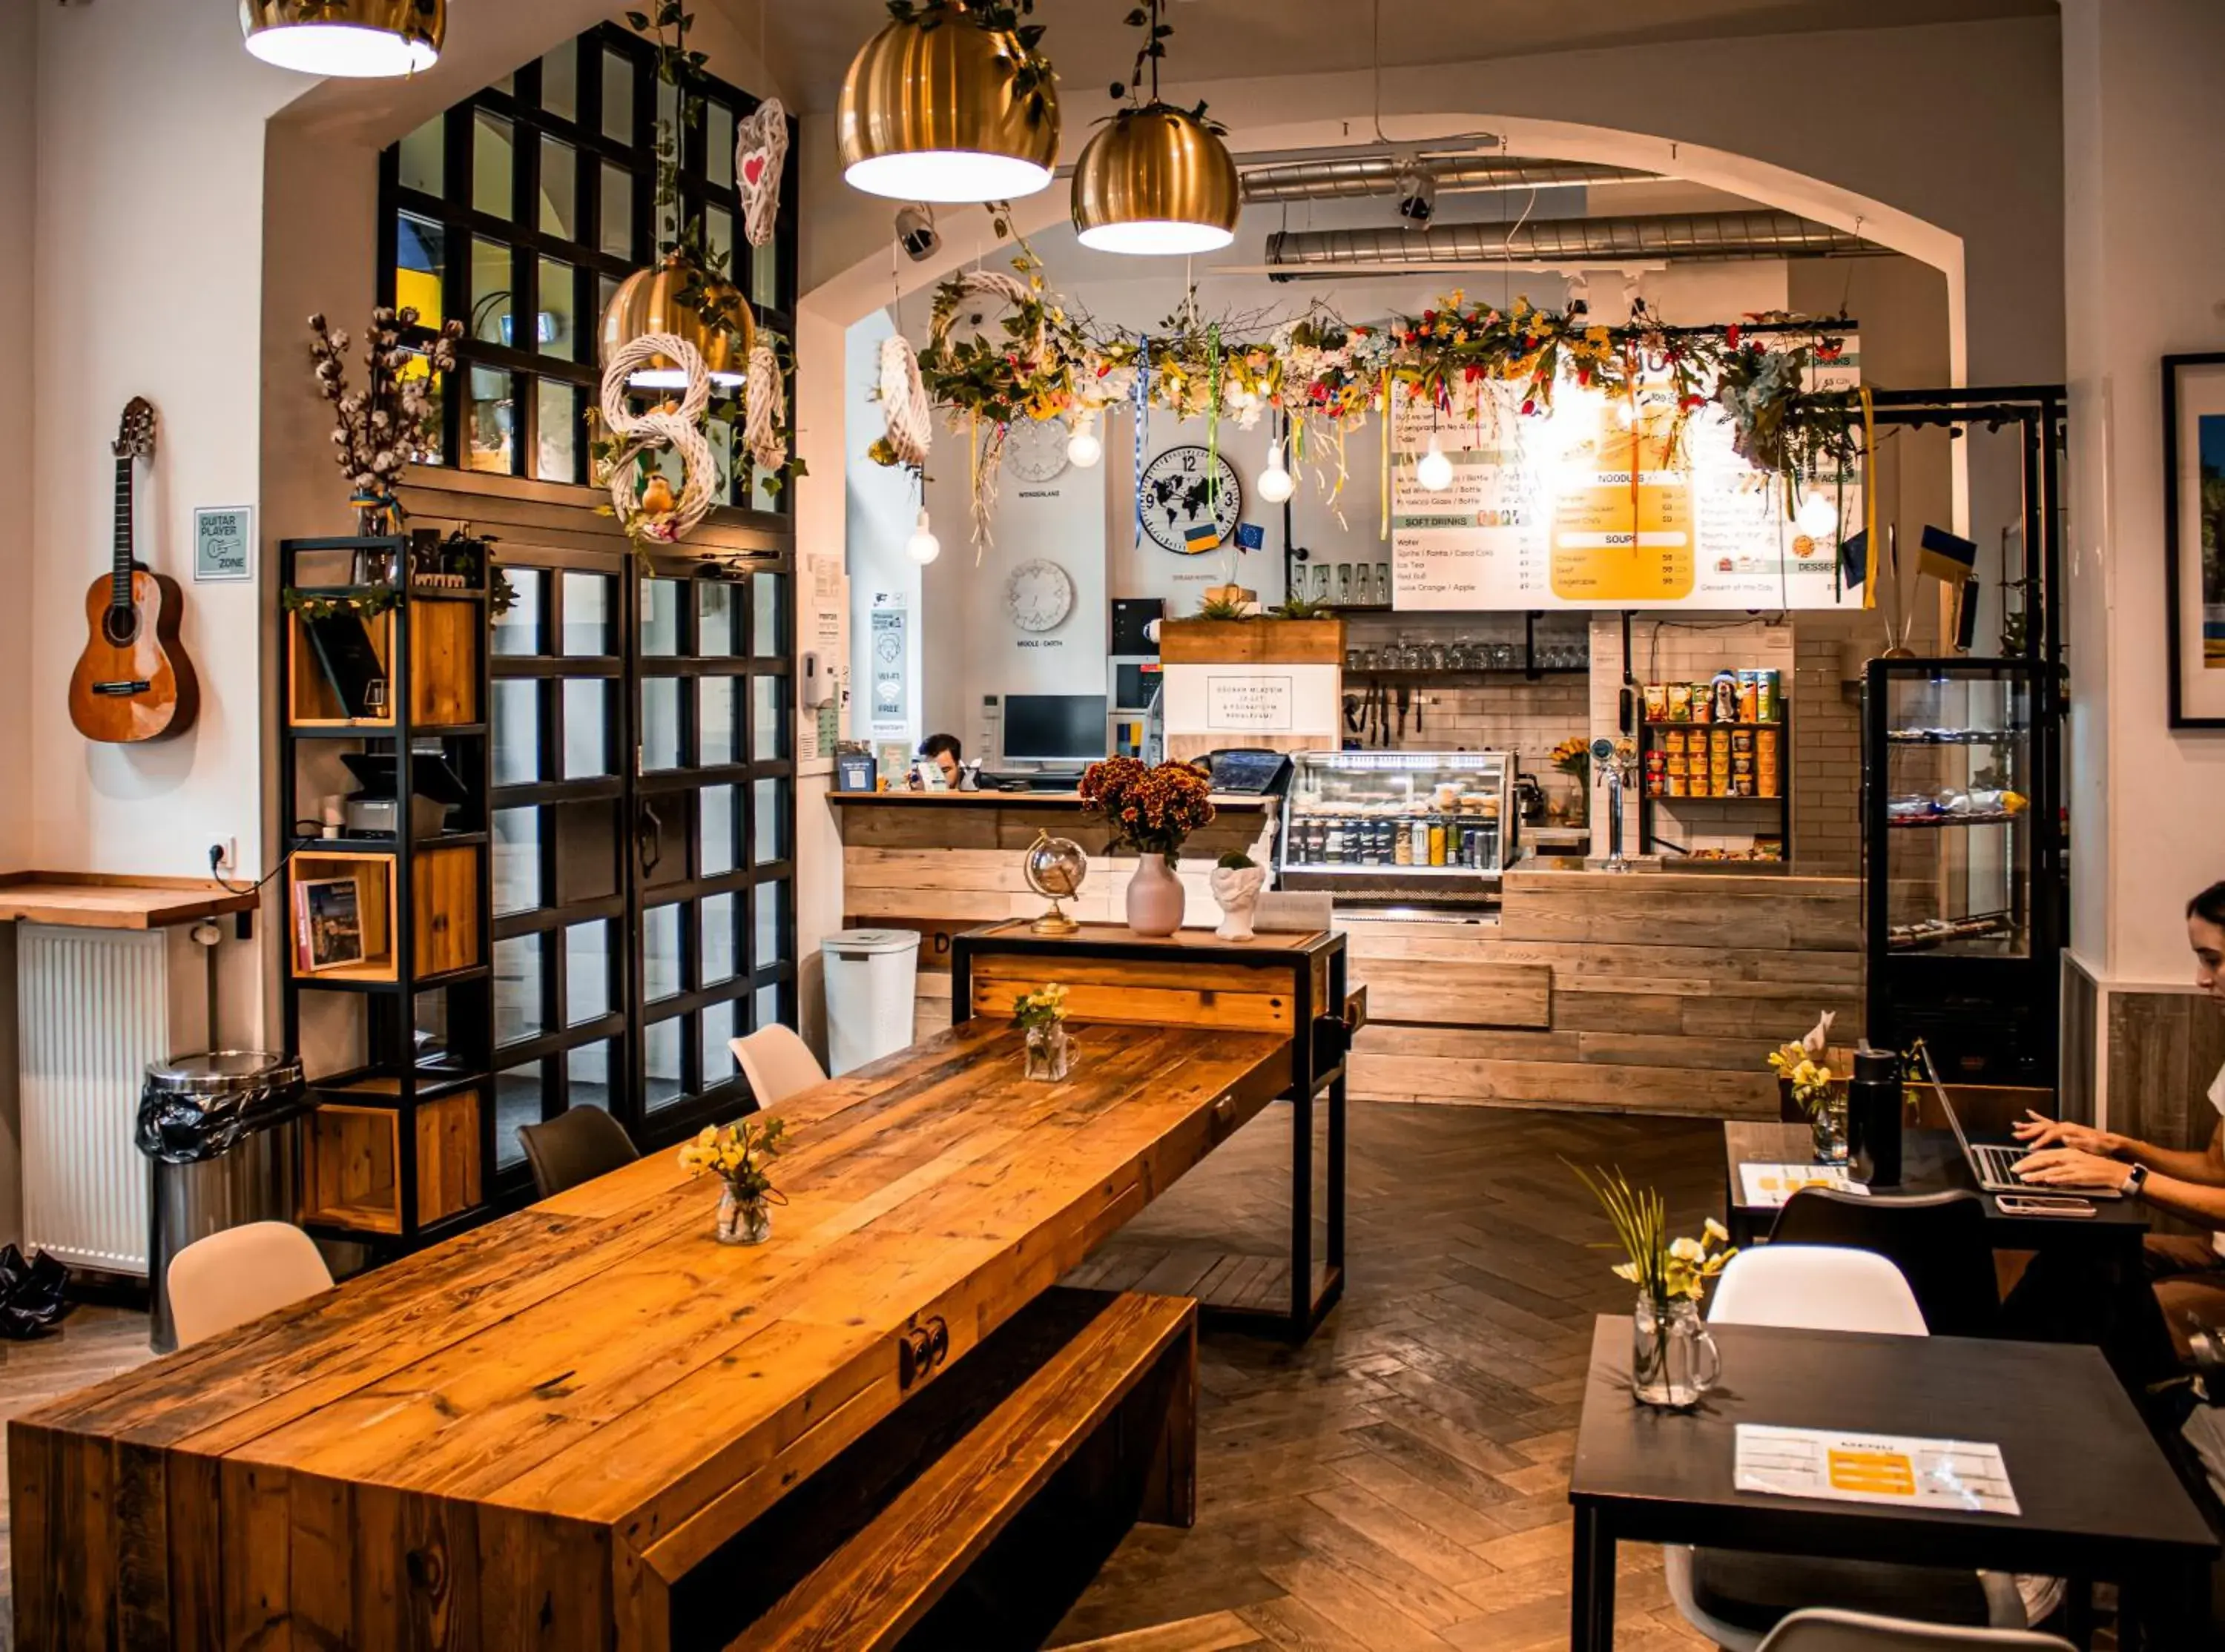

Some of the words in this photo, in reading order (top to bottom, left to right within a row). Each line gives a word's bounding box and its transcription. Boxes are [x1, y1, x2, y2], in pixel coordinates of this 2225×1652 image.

[1183, 456, 1196, 472] 12
[1146, 494, 1155, 509] 9
[1224, 492, 1233, 507] 3
[200, 515, 236, 526] GUITAR
[1405, 517, 1428, 526] SOFT
[1431, 516, 1468, 526] DRINKS
[201, 526, 237, 536] PLAYER
[1397, 538, 1420, 546] Water
[219, 558, 244, 569] ZONE
[1454, 583, 1477, 593] Apple
[877, 704, 900, 713] FREE
